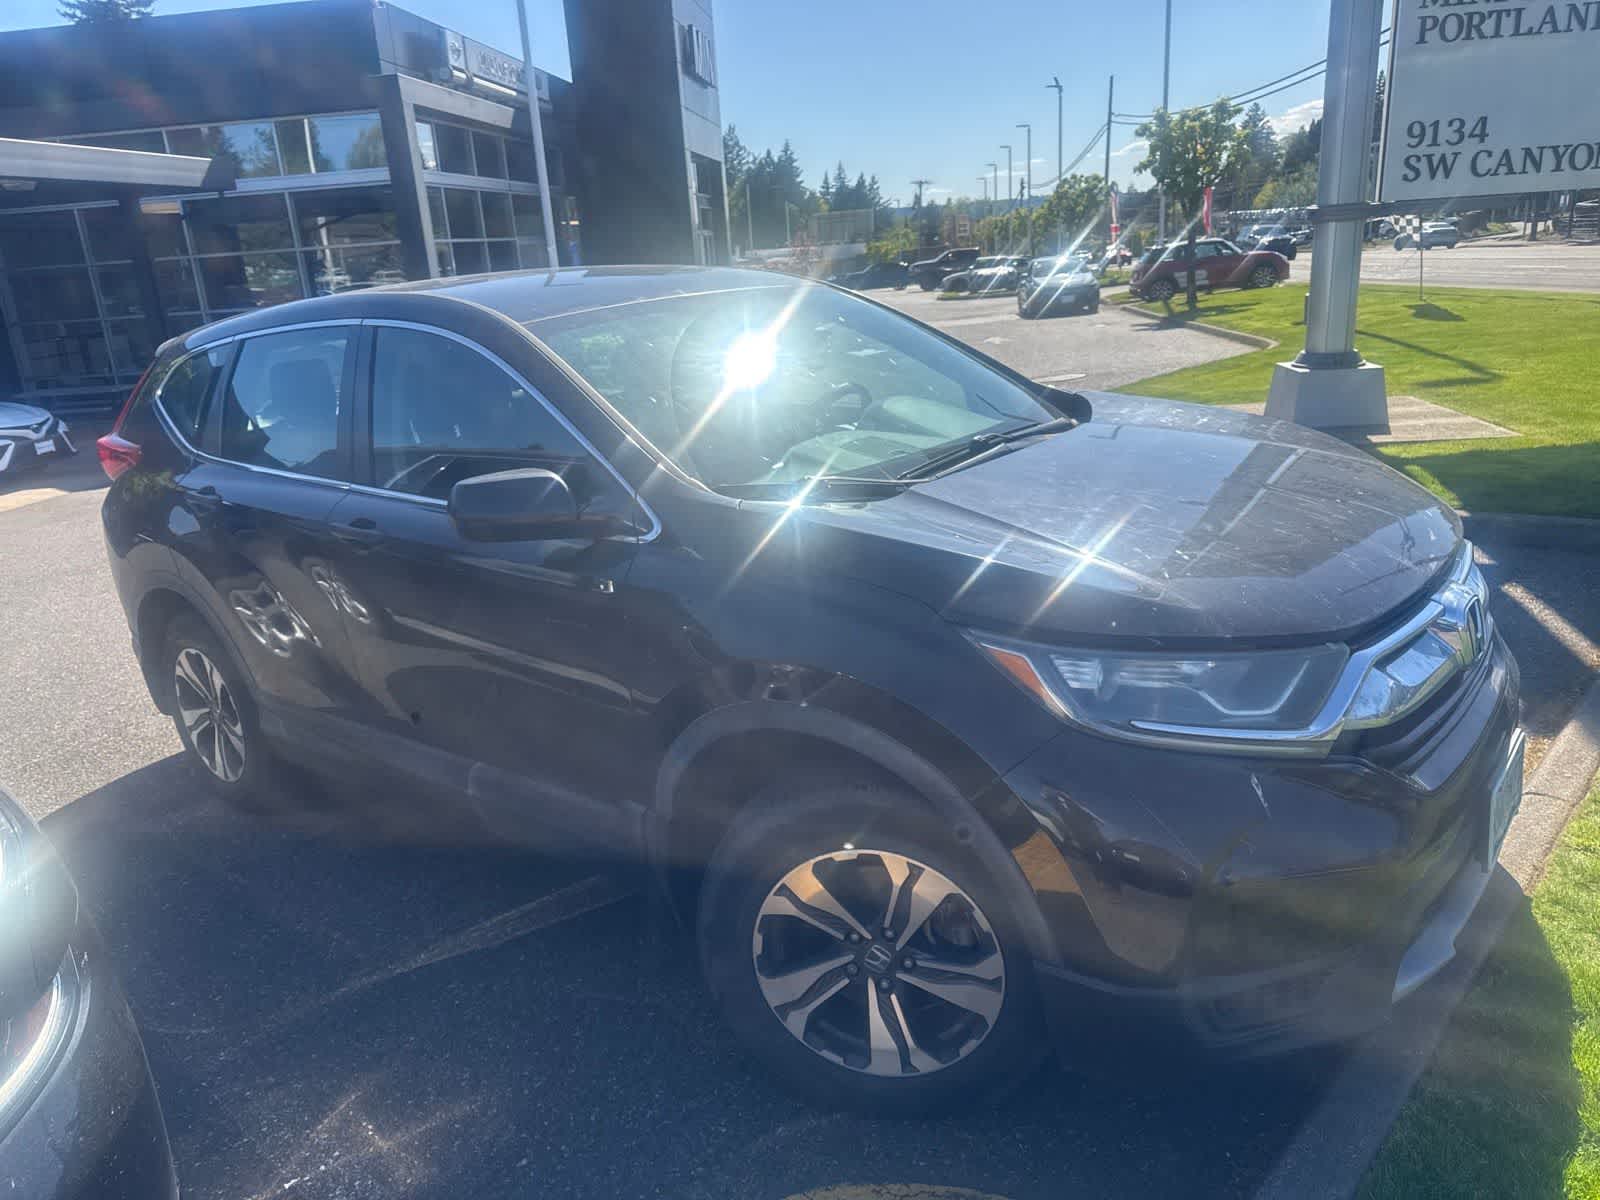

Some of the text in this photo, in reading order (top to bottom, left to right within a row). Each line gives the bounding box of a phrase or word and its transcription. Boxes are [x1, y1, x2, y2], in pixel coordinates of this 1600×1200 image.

[1406, 116, 1489, 148] 9134
[1402, 142, 1600, 182] SW CANYO
